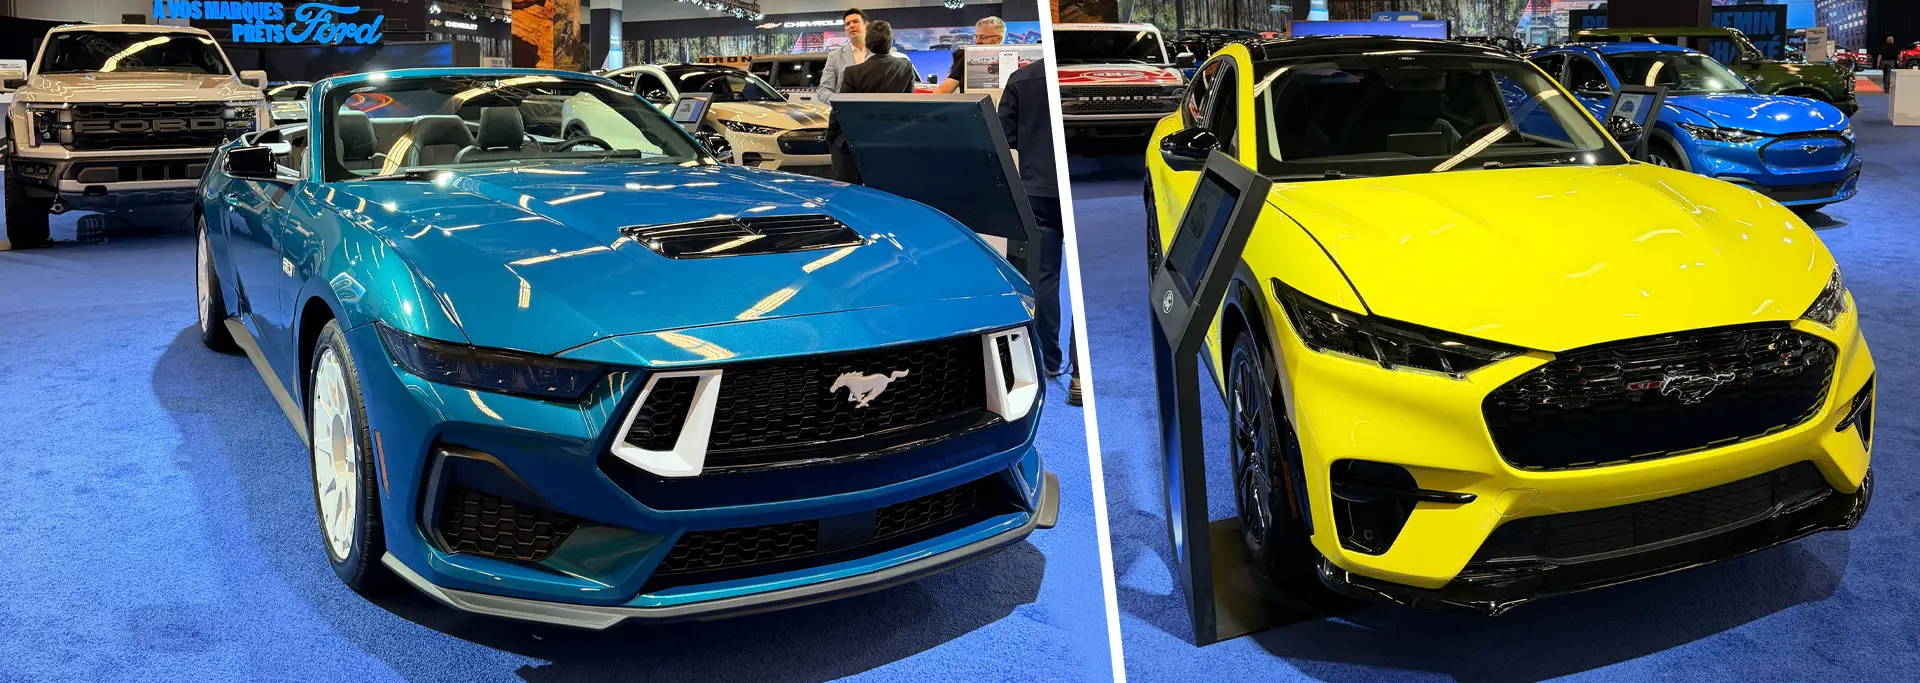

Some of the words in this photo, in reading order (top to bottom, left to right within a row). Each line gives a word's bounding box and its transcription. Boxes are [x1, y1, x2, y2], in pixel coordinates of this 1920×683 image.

[166, 0, 203, 20] VOS
[203, 1, 284, 23] MARQUES
[286, 2, 384, 44] Ford
[232, 20, 284, 43] PRÊTS
[445, 20, 478, 30] CHEVROLET
[75, 118, 224, 133] FORD
